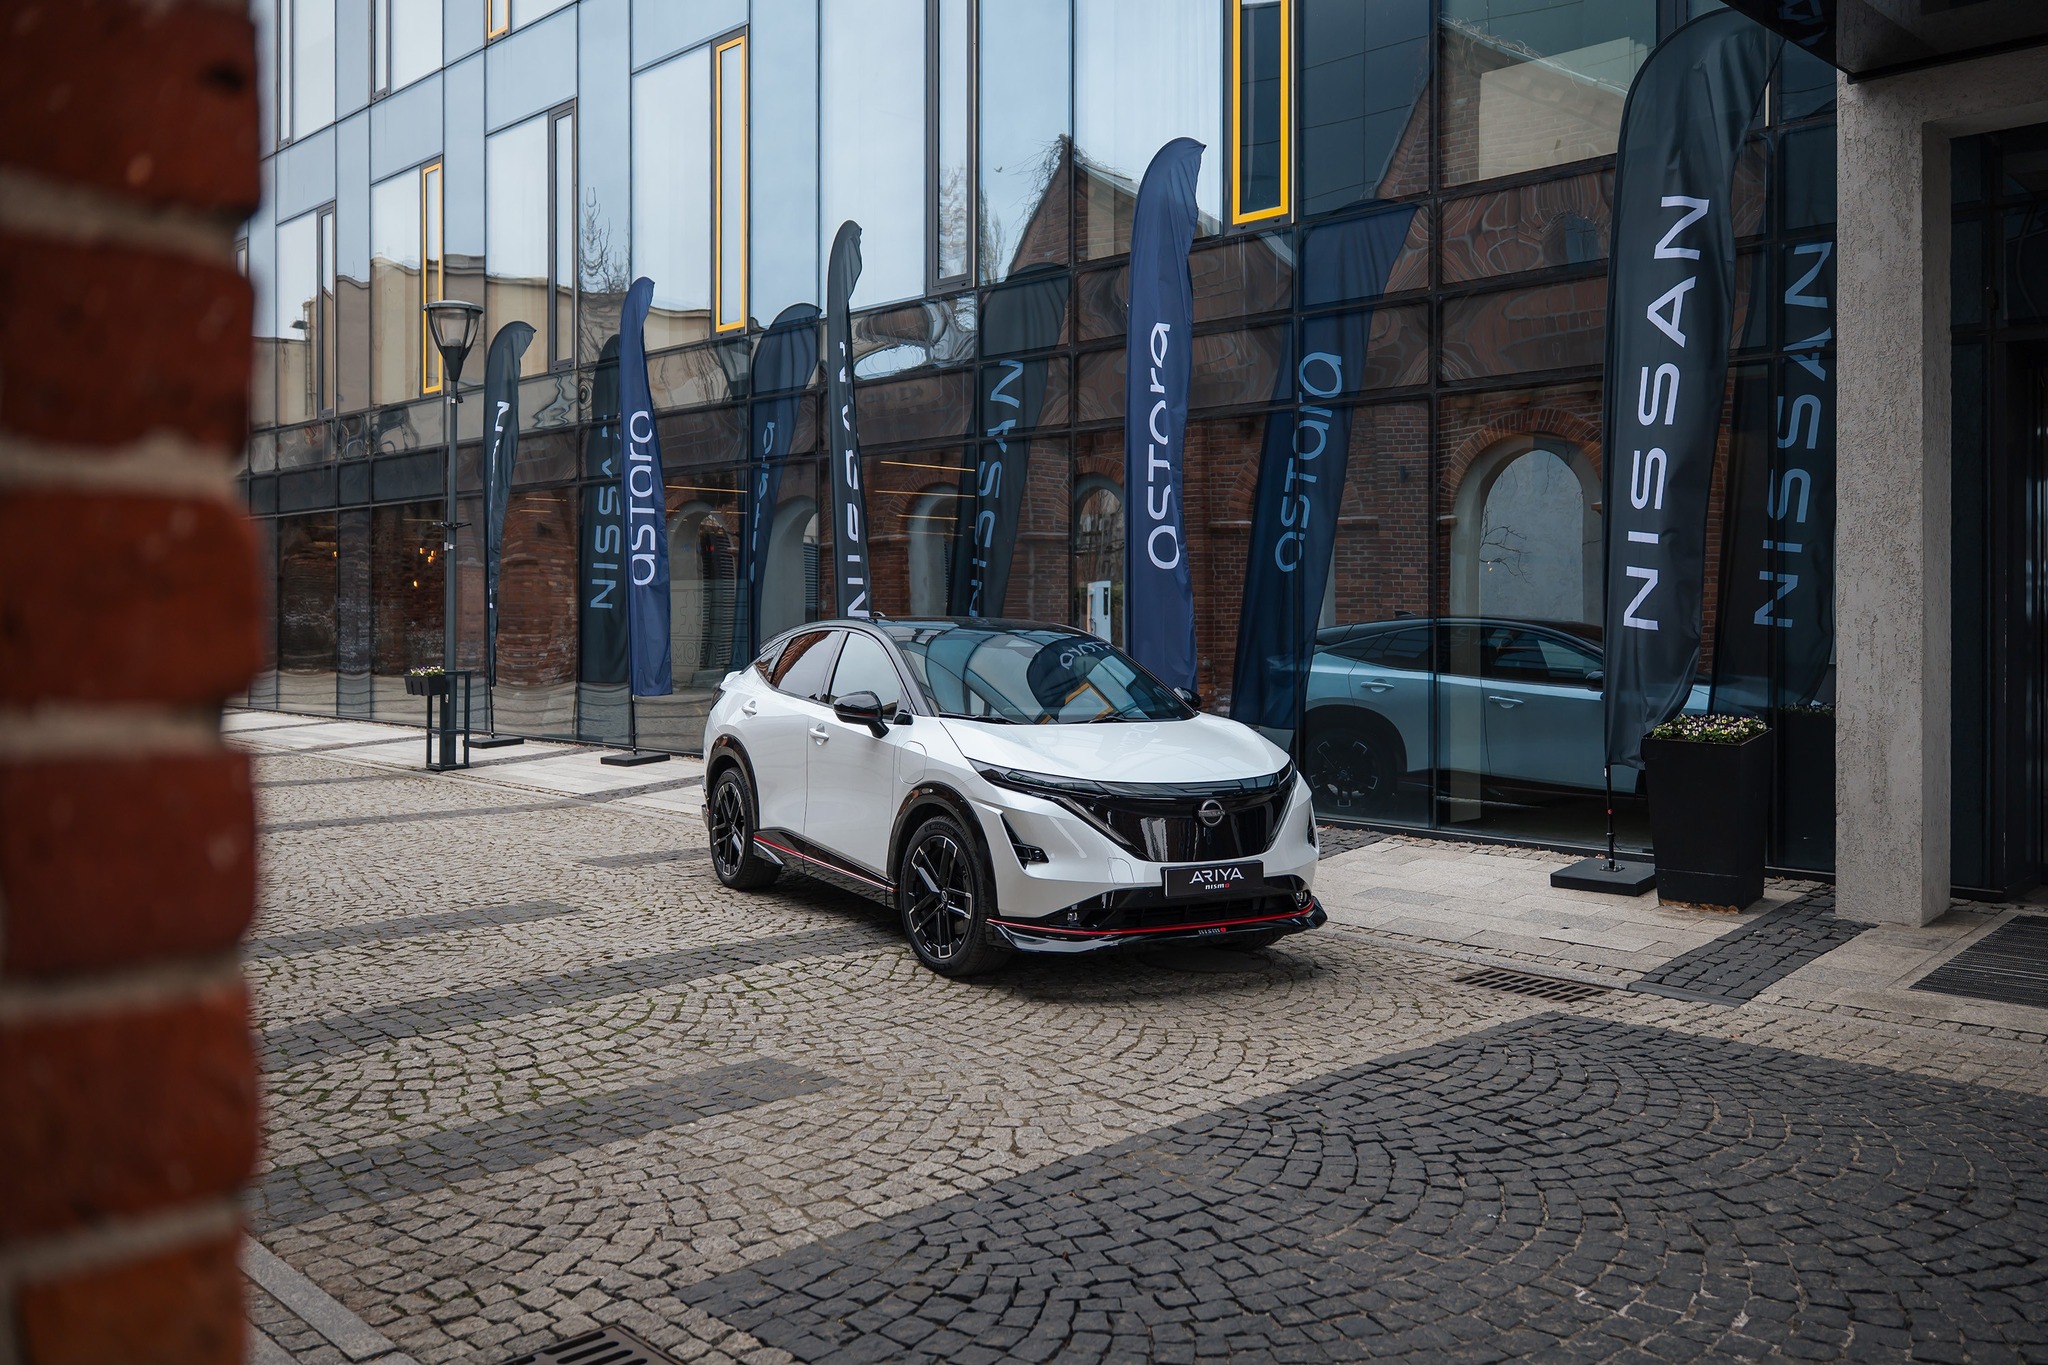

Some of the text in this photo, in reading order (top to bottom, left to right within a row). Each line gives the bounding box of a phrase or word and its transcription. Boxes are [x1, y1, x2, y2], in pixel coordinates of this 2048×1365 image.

[1623, 195, 1709, 631] NISSAN
[1754, 241, 1833, 628] NISSAN
[1189, 867, 1244, 884] ARIYA
